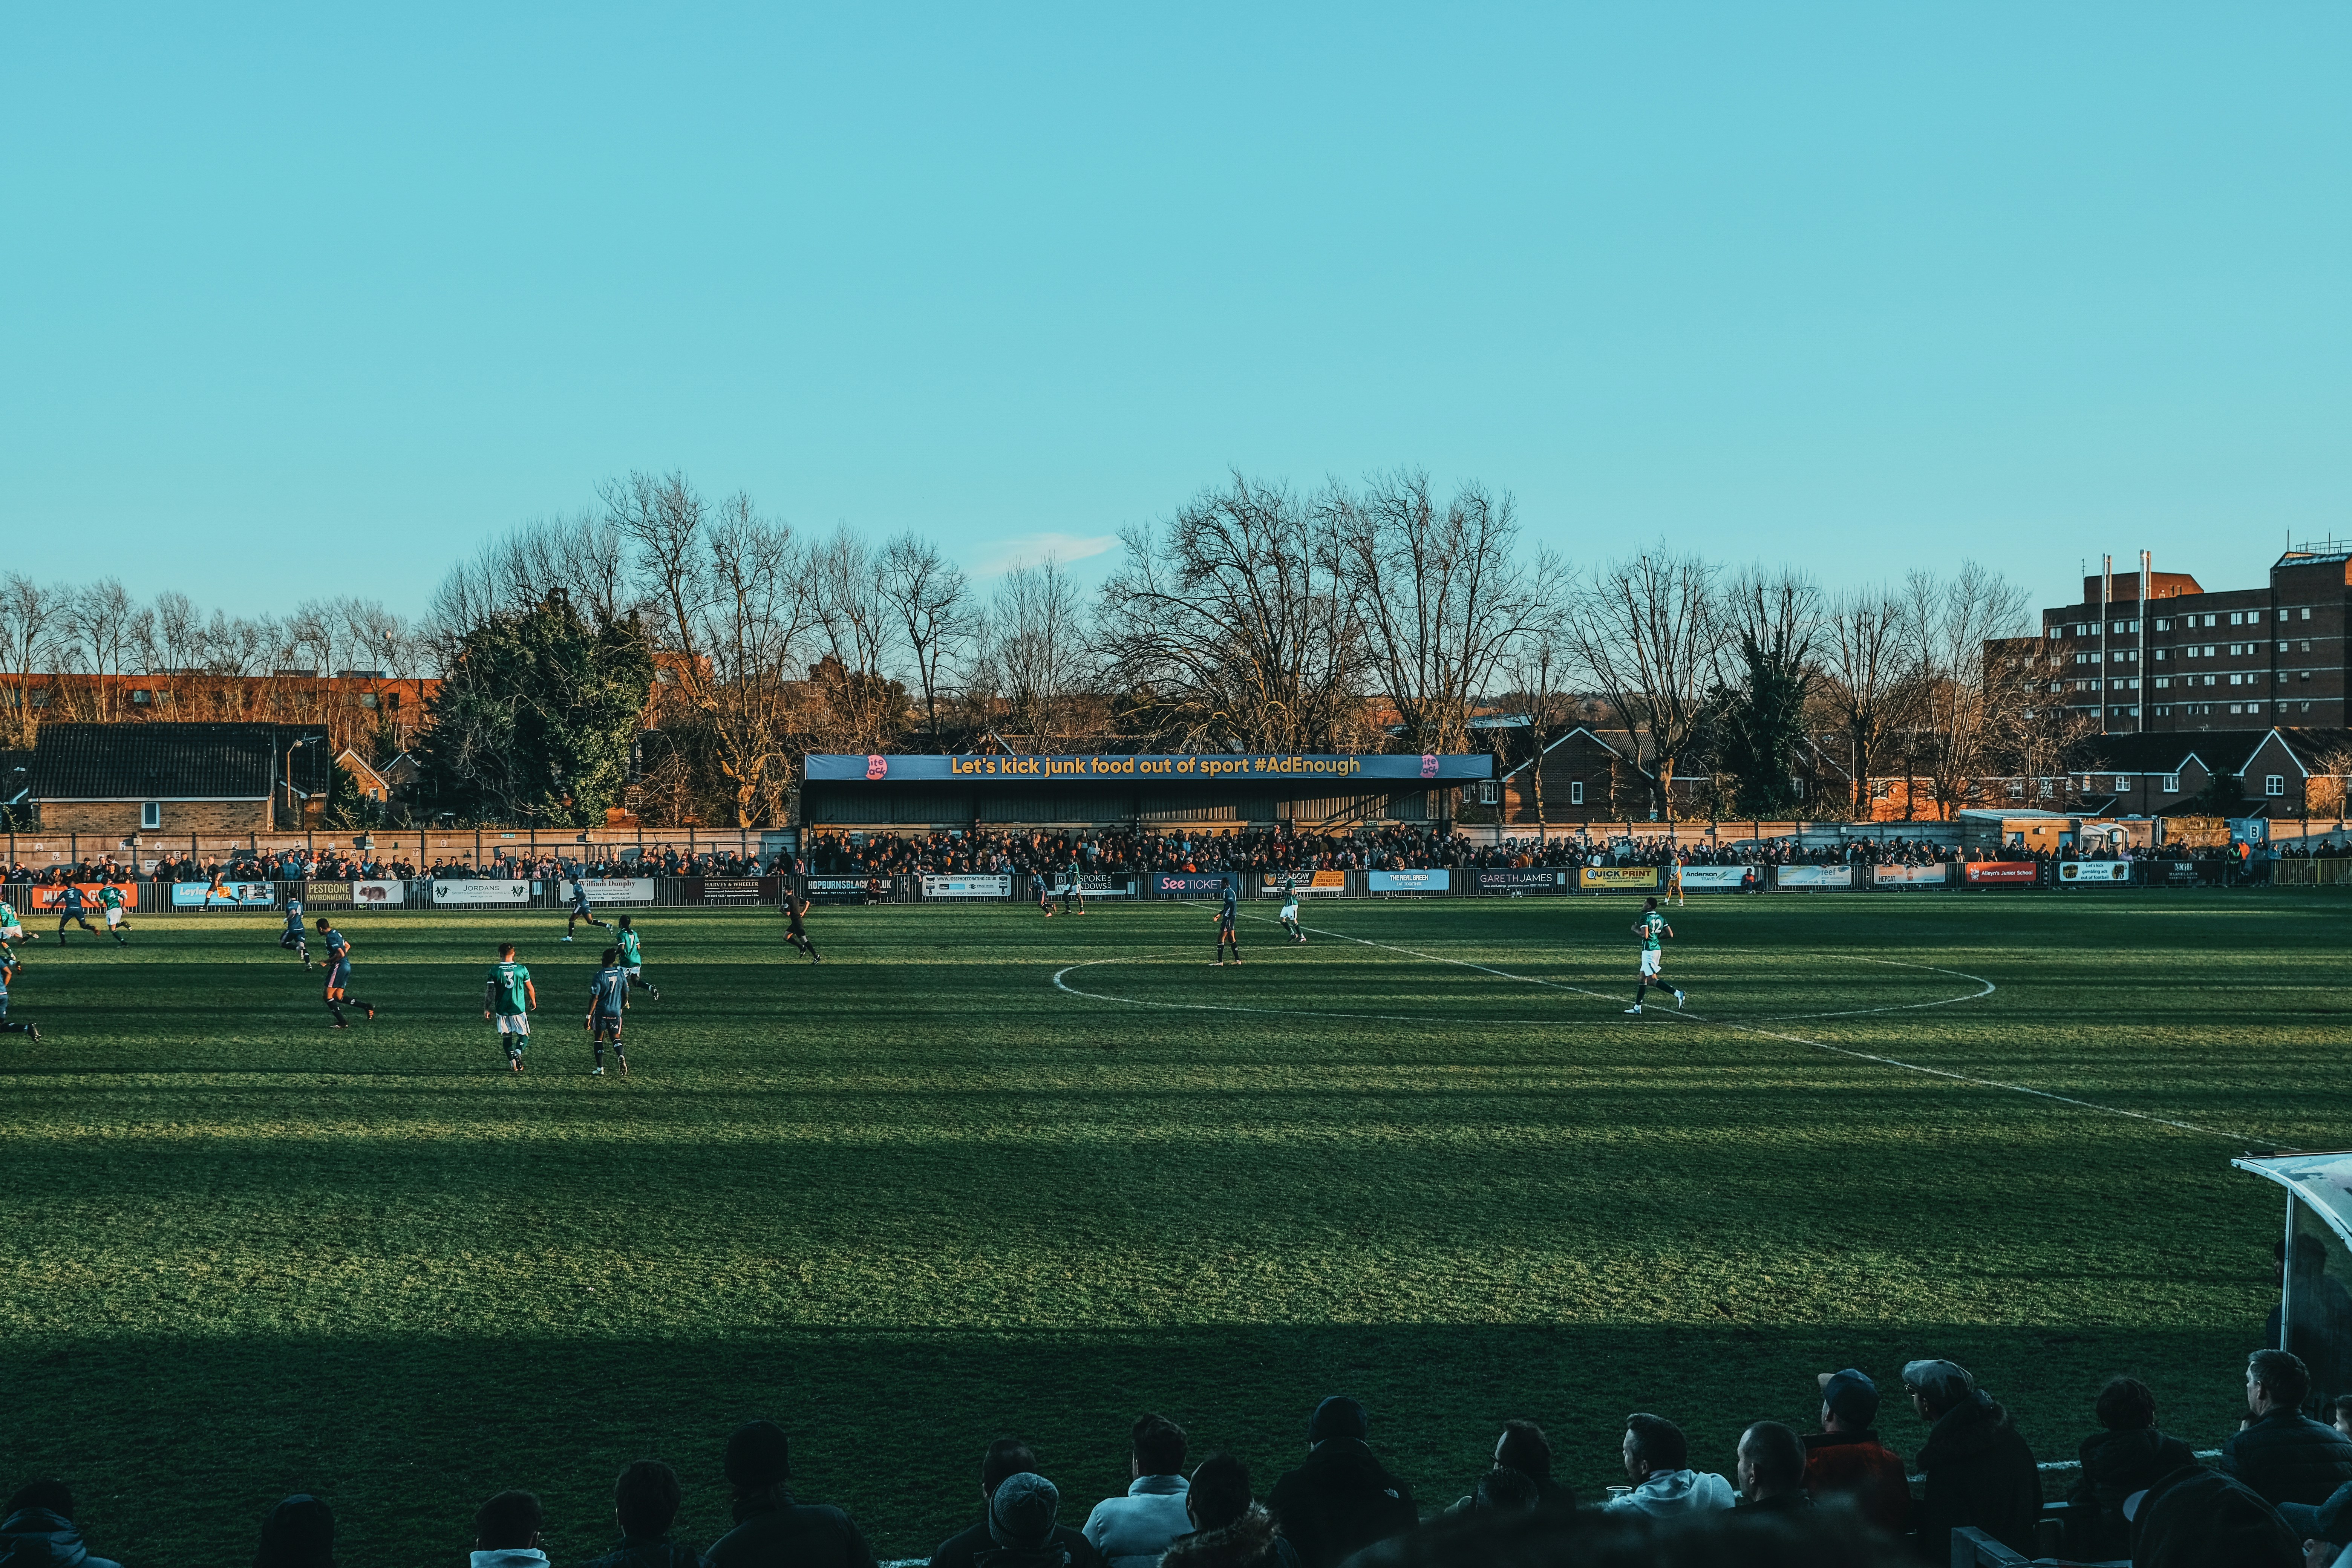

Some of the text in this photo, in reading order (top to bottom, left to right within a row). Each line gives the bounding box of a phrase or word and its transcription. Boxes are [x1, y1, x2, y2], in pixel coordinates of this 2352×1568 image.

[952, 756, 1360, 778] Let's kick junk food out of sport #AdEnough
[2252, 827, 2257, 837] B
[1480, 874, 1552, 882] GARETH JAMES
[1586, 869, 1620, 880] QUICK
[309, 884, 349, 893] PESTGONE
[1161, 877, 1222, 890] See TICKET
[68, 890, 74, 899] 3
[109, 890, 116, 898] 4
[1651, 919, 1662, 934] 12
[504, 971, 514, 989] 3
[608, 976, 617, 993] 7
